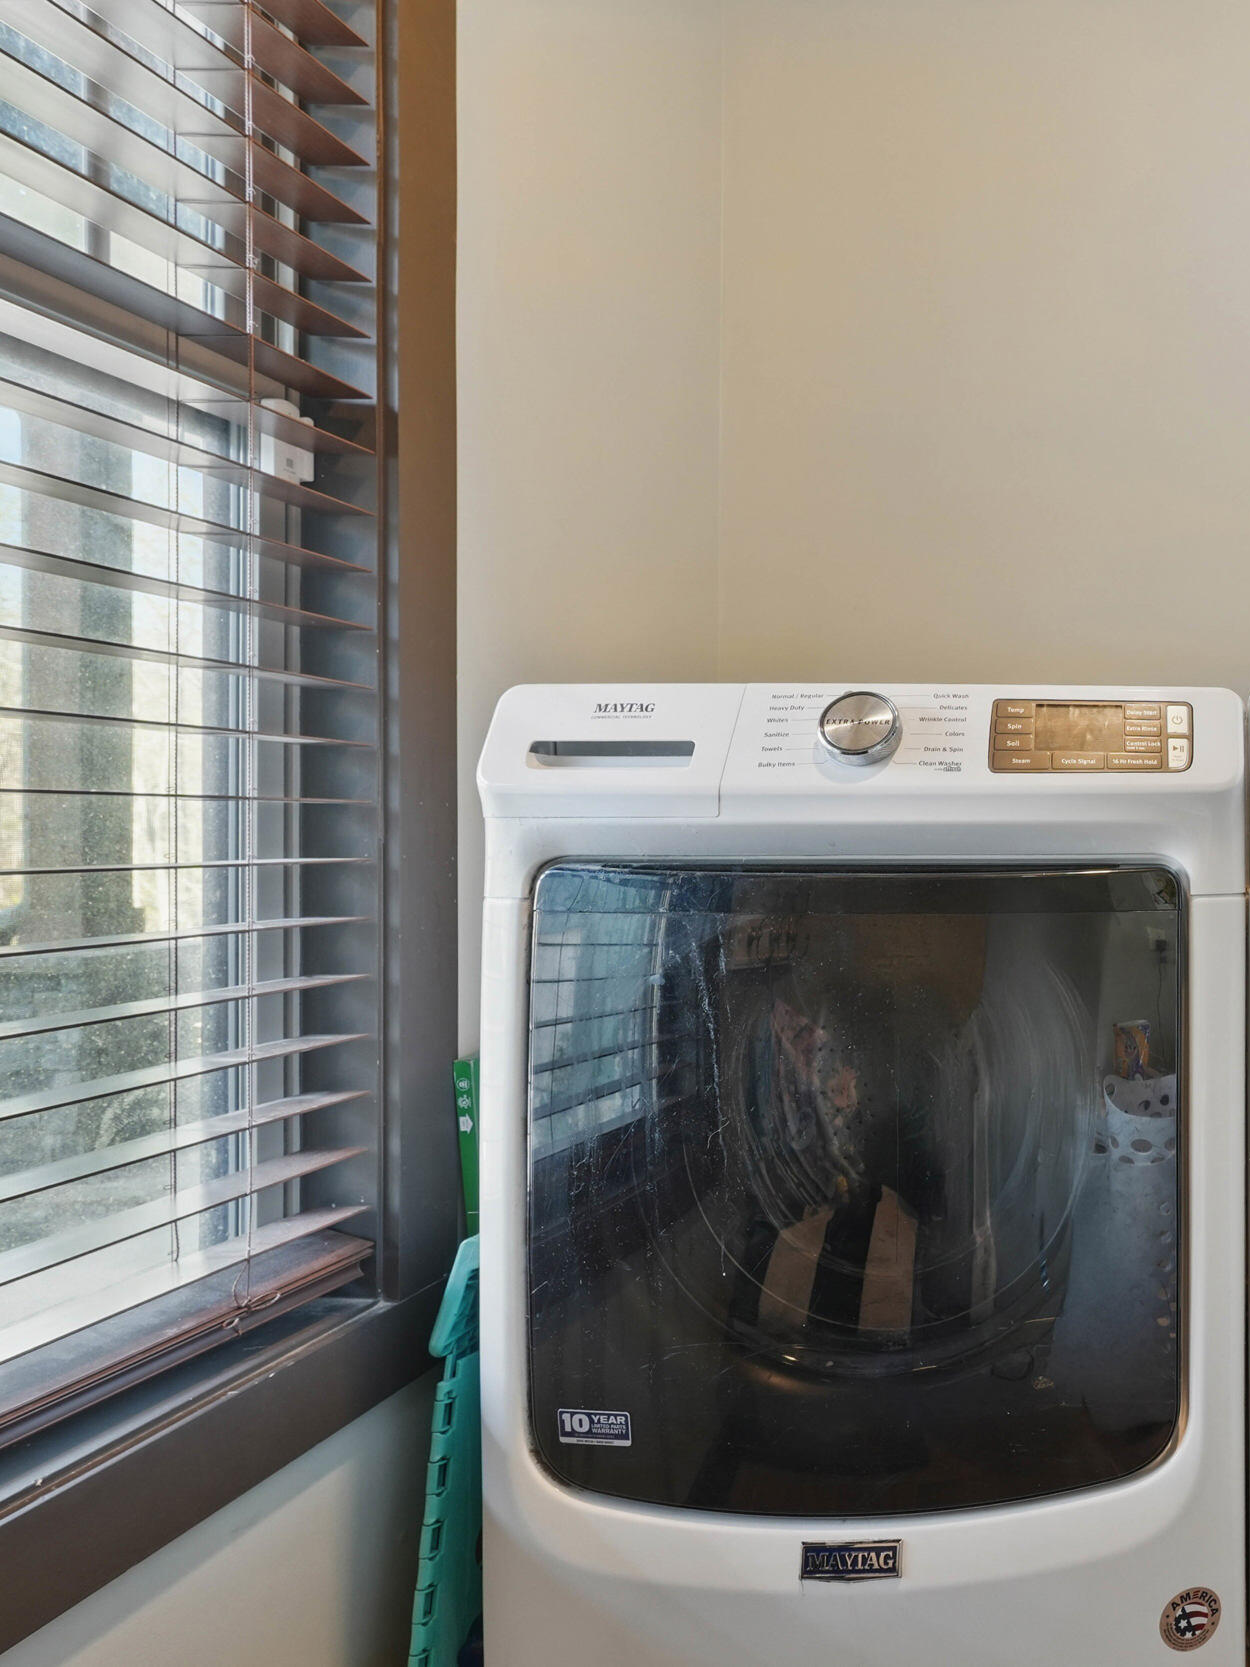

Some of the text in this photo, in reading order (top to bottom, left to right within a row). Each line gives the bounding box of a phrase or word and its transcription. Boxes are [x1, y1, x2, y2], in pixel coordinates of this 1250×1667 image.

[593, 702, 656, 713] MAYTAG
[562, 1413, 625, 1432] 10 YEAR
[807, 1551, 894, 1570] MAYTAG
[1171, 1590, 1219, 1617] AMERICA
